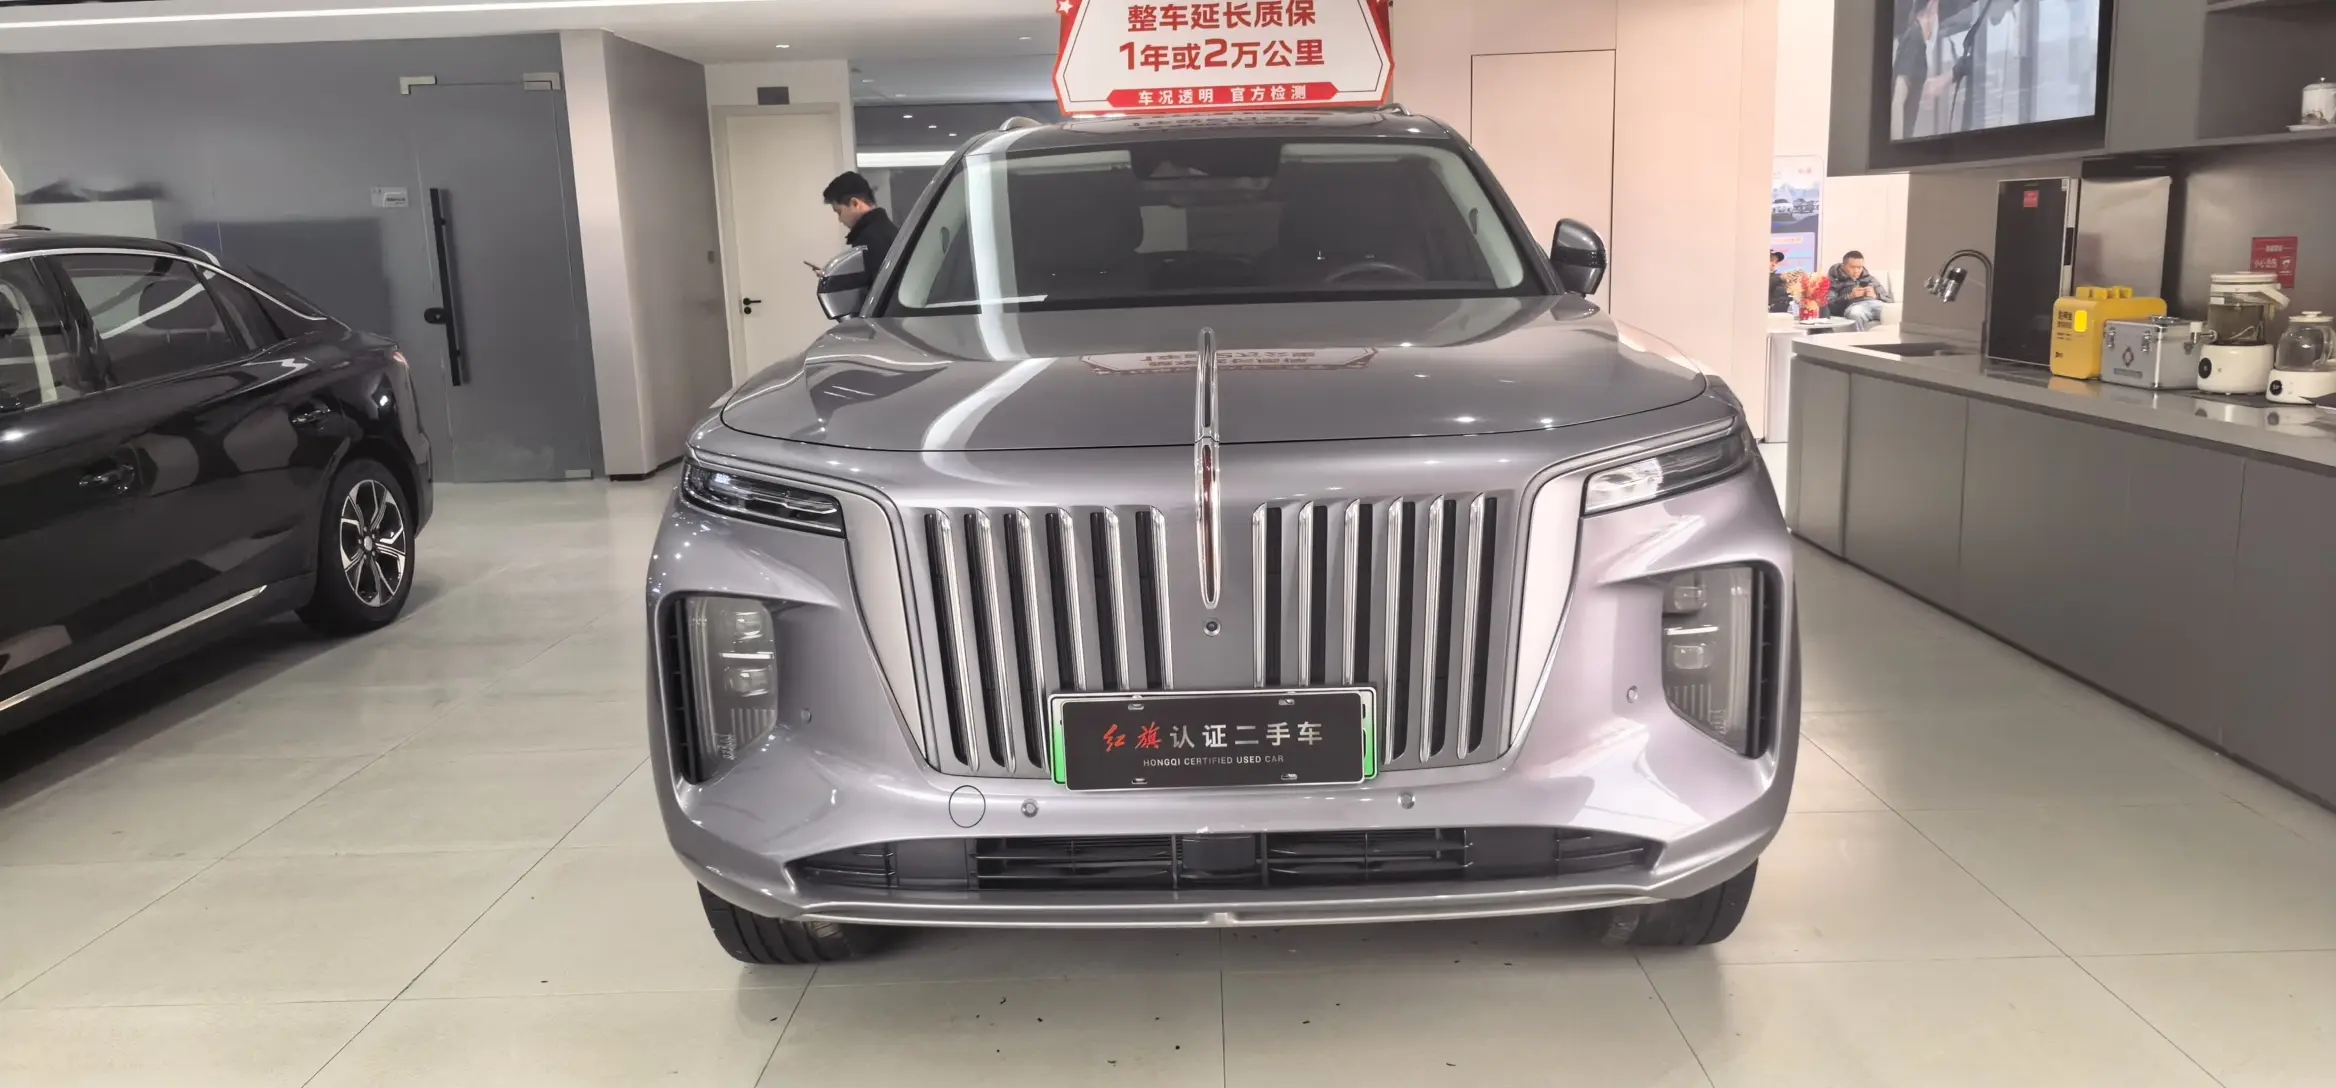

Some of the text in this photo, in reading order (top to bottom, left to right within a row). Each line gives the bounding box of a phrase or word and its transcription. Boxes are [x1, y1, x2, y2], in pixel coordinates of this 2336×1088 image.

[1128, 0, 1316, 32] 整车延长质保
[1119, 38, 1325, 72] 1年或2万公里
[1138, 85, 1307, 106] 车况透明 官方检测
[1143, 754, 1284, 767] HONGQI CERTIFIED USED CAR
